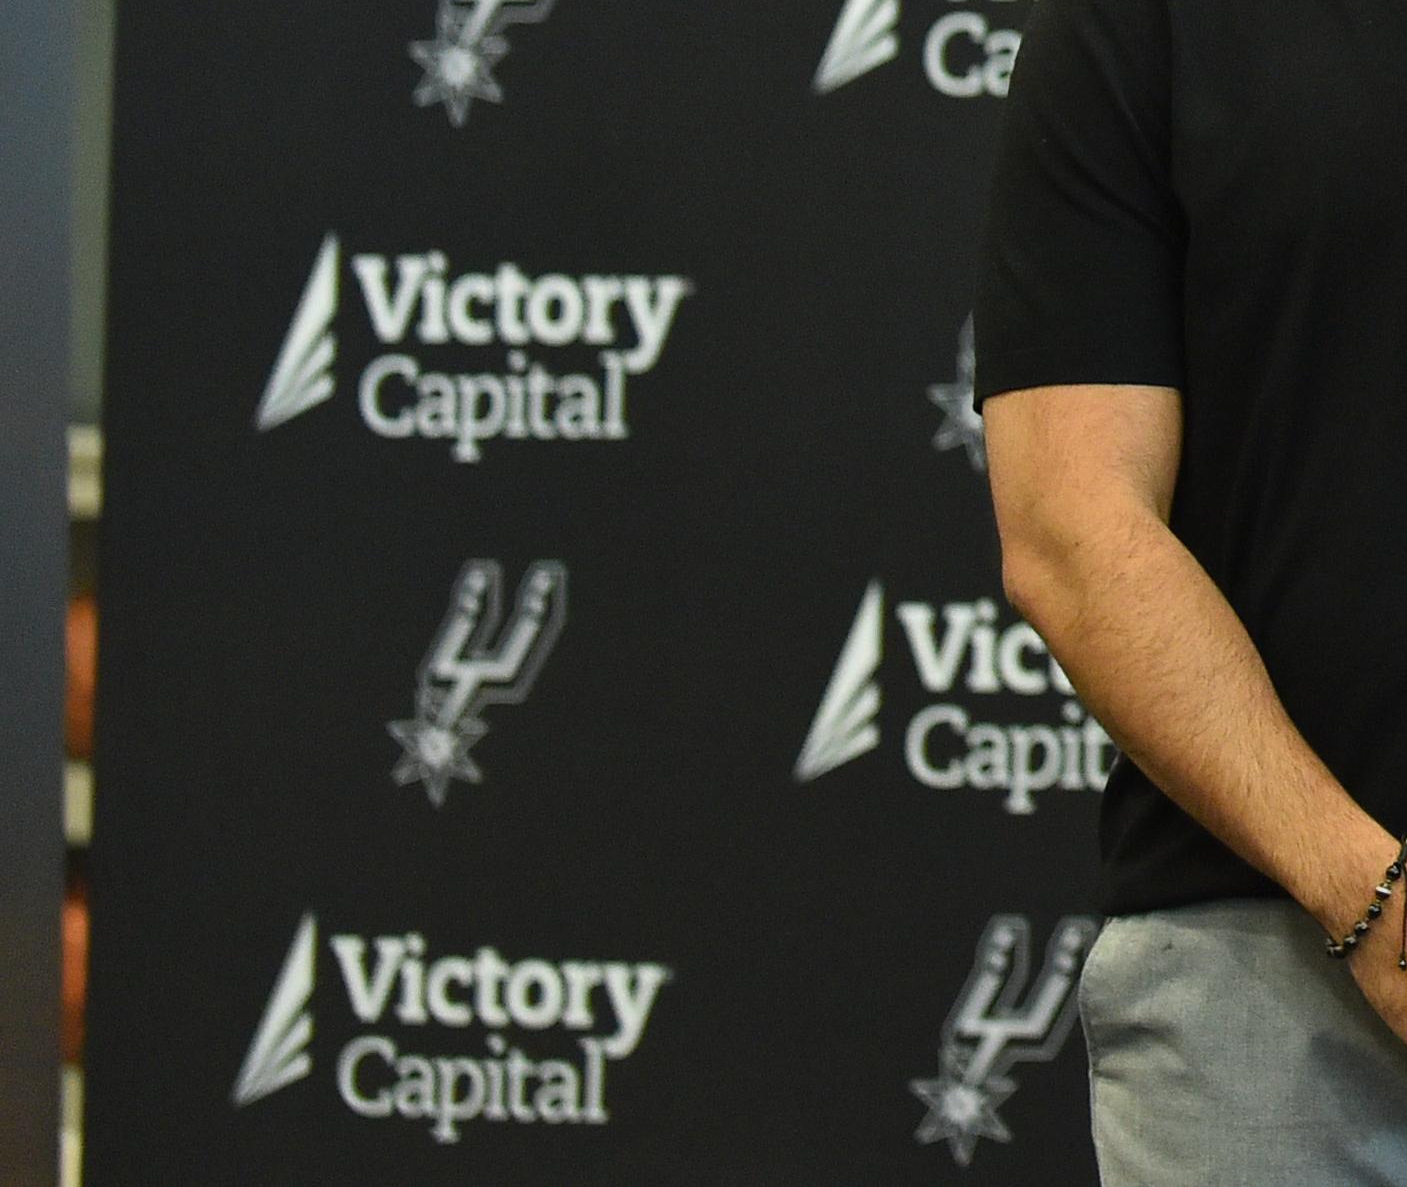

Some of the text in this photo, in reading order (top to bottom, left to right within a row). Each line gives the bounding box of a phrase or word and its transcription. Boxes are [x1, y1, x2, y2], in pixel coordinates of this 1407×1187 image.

[350, 249, 686, 375] Victory
[357, 349, 629, 464] Capital
[904, 701, 1115, 815] Capit
[330, 932, 669, 1059] Victory
[336, 1034, 609, 1145] Capital
